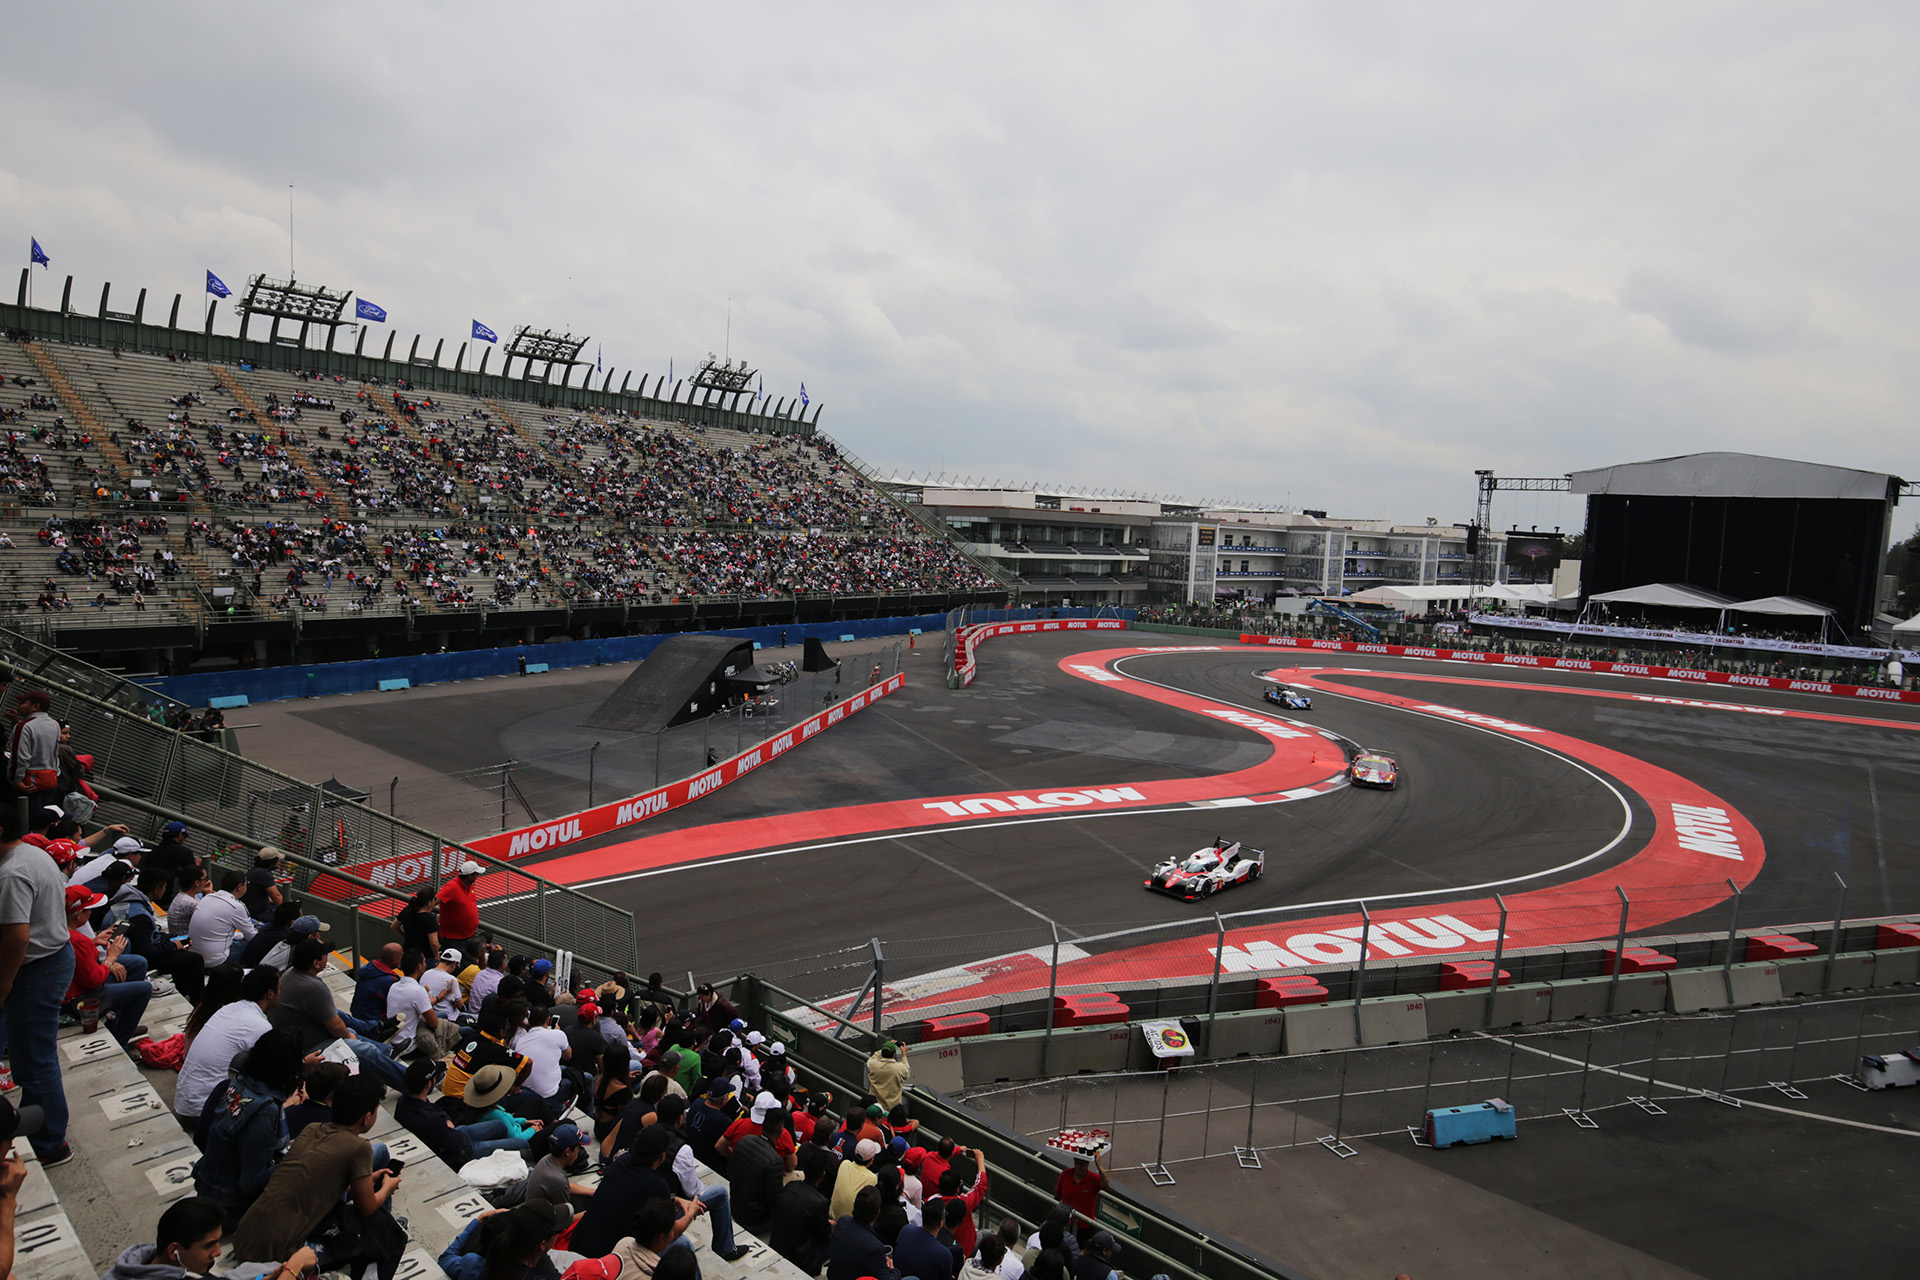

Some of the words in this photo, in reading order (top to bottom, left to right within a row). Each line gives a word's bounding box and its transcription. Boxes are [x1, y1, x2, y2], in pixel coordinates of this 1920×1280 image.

[363, 305, 380, 316] Ford
[475, 325, 495, 339] Ford
[1020, 624, 1037, 632] MOTUL
[1043, 622, 1060, 630] MOTUL
[1067, 621, 1088, 629] MOTUL
[1267, 636, 1297, 646] MOTUL
[1312, 640, 1343, 650] MOTUL
[1356, 644, 1388, 653] MOTUL
[1404, 647, 1437, 657] MOTUL
[1451, 651, 1486, 661] MOTUL
[1503, 656, 1539, 666] MOTUL
[1555, 659, 1592, 669] MOTUL
[1611, 663, 1650, 674] MOTUL
[1667, 668, 1708, 680] MOTUL
[1728, 674, 1770, 687] MOTUL
[1789, 680, 1833, 693] MOTUL
[1856, 687, 1902, 700] MOTUL
[828, 706, 844, 725] MOTUL
[802, 718, 821, 739] MOTUL
[771, 733, 793, 757] MOTUL
[737, 749, 762, 776] MOTUL
[687, 769, 723, 800] MOTUL
[616, 791, 669, 826] MOTUL
[922, 787, 1147, 817] MOTUL
[508, 818, 583, 858] MOTUL
[1671, 802, 1745, 862] MOTUL
[1208, 914, 1511, 974] MOTUL
[1406, 1003, 1423, 1011] 1040
[1109, 1033, 1129, 1041] 1042
[938, 1048, 959, 1058] 1043
[390, 1139, 417, 1155] 14
[454, 1198, 484, 1217] 12
[18, 1223, 61, 1253] 10
